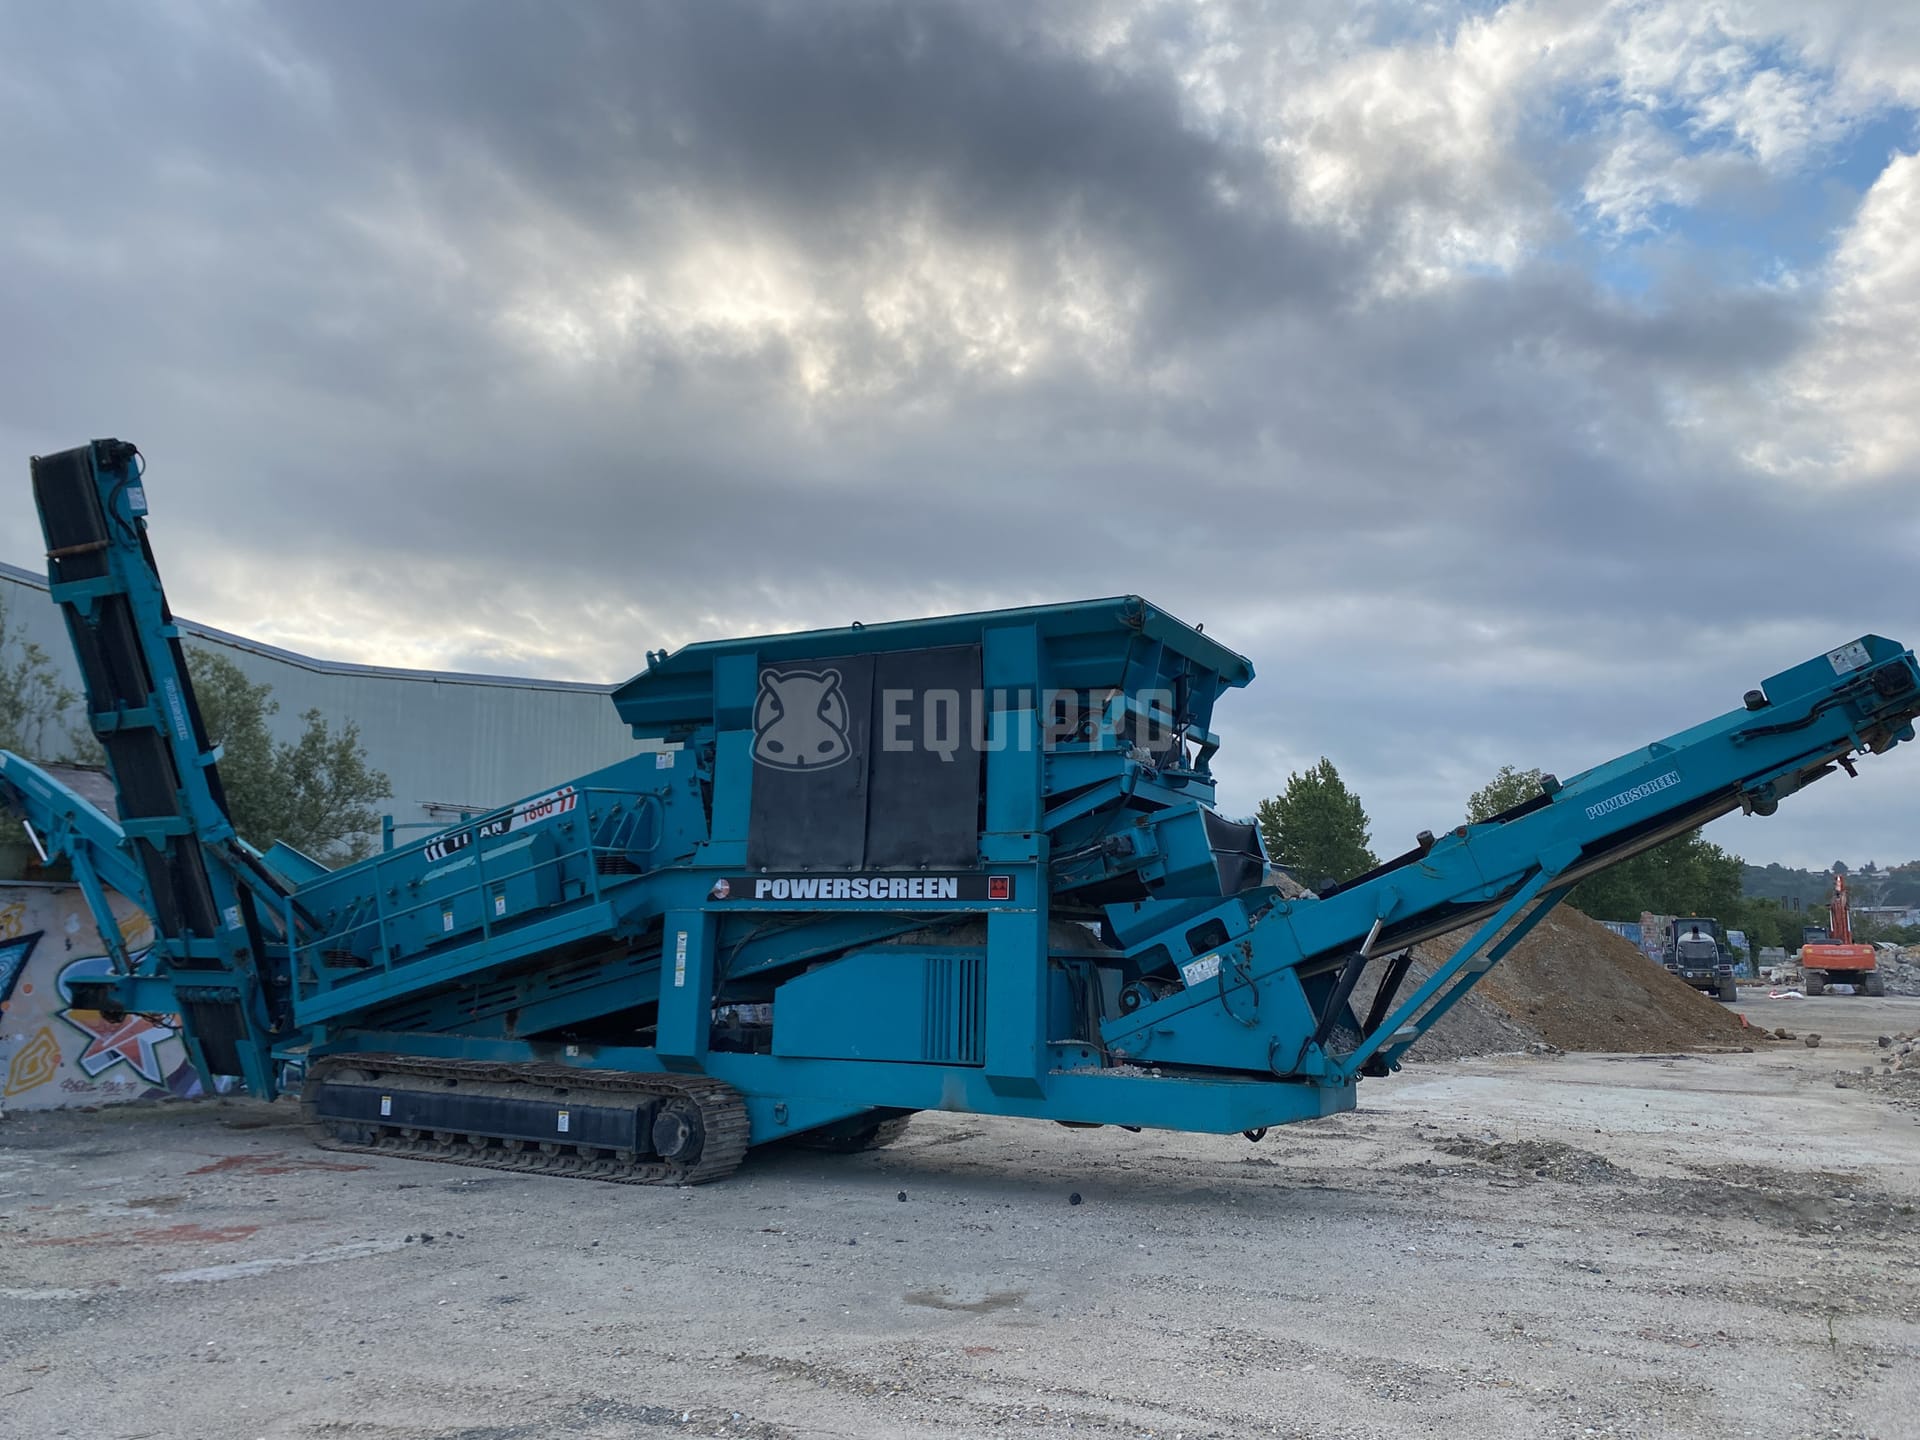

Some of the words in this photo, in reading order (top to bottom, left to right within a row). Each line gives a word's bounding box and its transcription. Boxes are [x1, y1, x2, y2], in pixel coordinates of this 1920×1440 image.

[1584, 770, 1681, 820] POWERSCREEN
[452, 822, 503, 848] TIAN
[754, 877, 959, 899] POWERSCREEN
